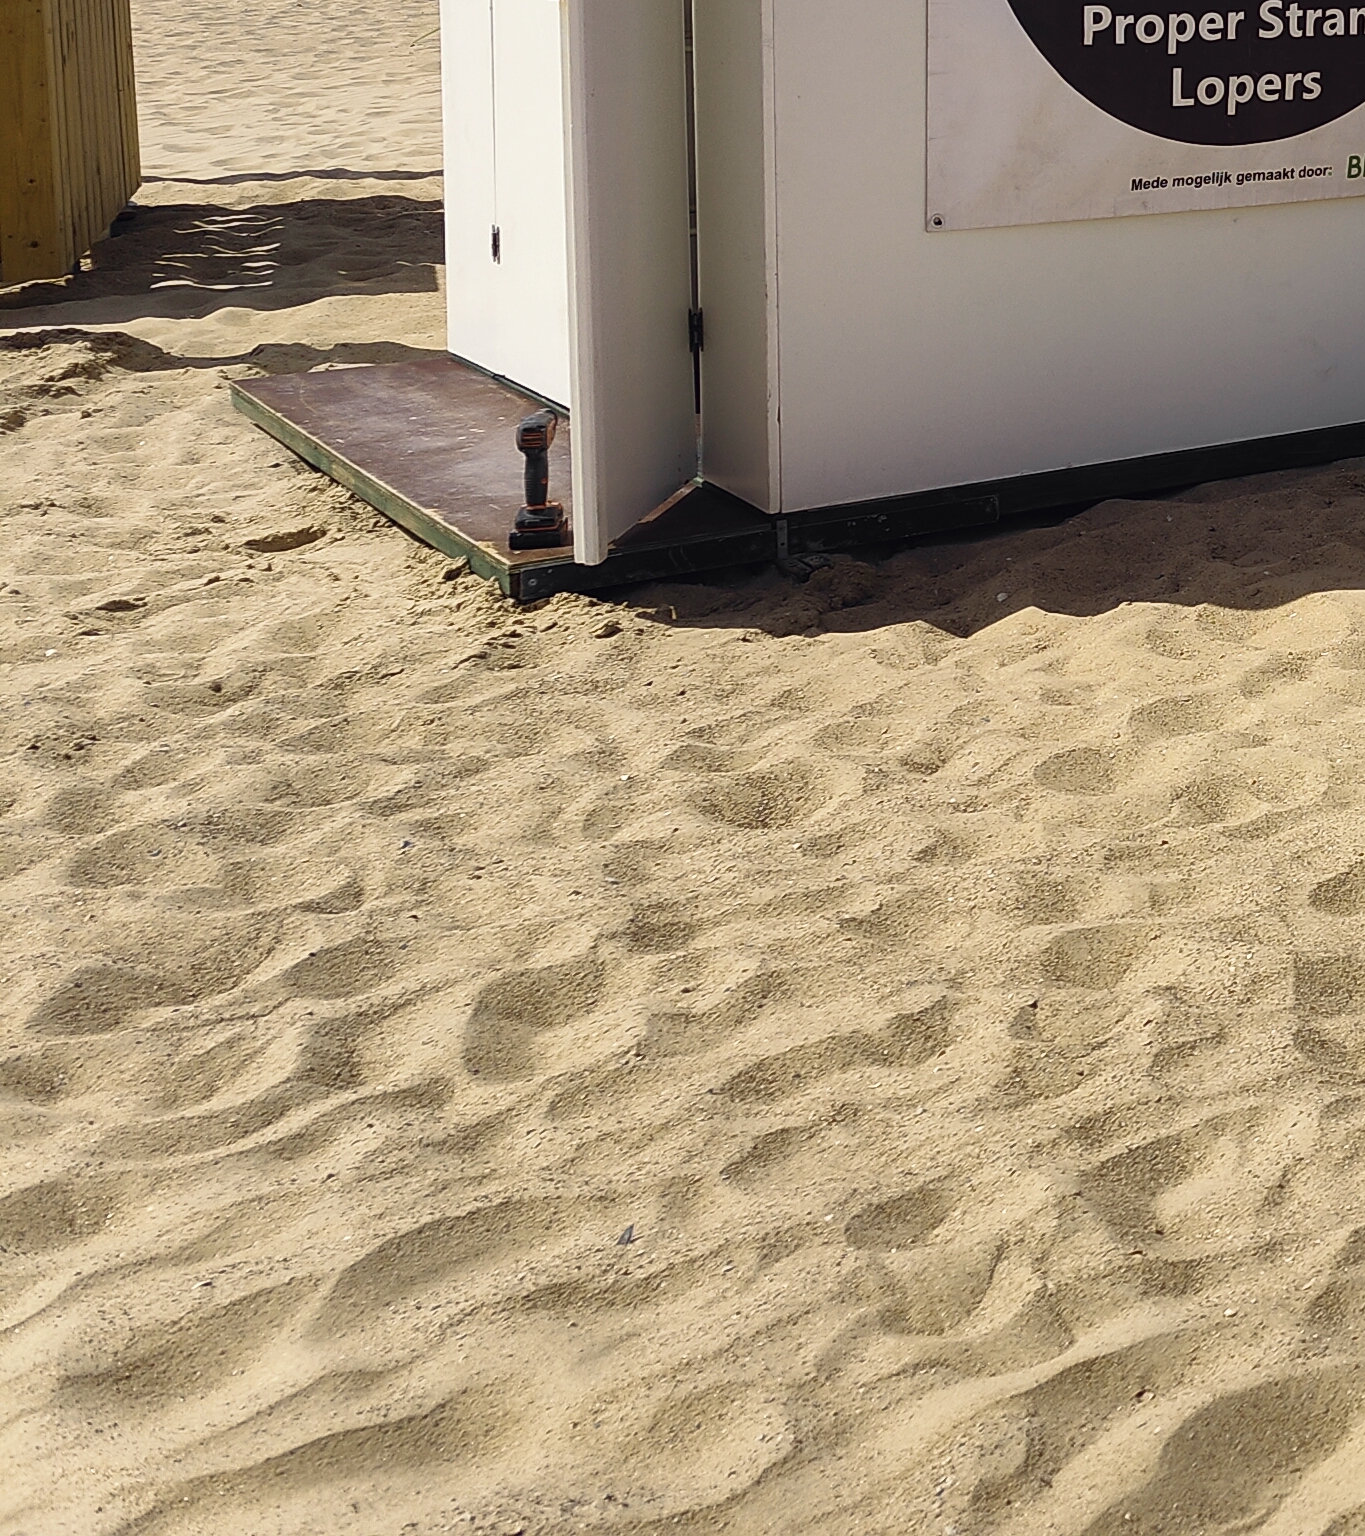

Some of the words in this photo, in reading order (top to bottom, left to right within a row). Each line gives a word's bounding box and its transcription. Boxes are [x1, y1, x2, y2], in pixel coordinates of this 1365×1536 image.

[1083, 3, 1245, 54] Proper
[1172, 68, 1322, 115] Lopers
[1131, 176, 1168, 191] Mede
[1172, 170, 1232, 189] mogelijk
[1236, 167, 1295, 185] gemaakt
[1298, 164, 1333, 180] door:
